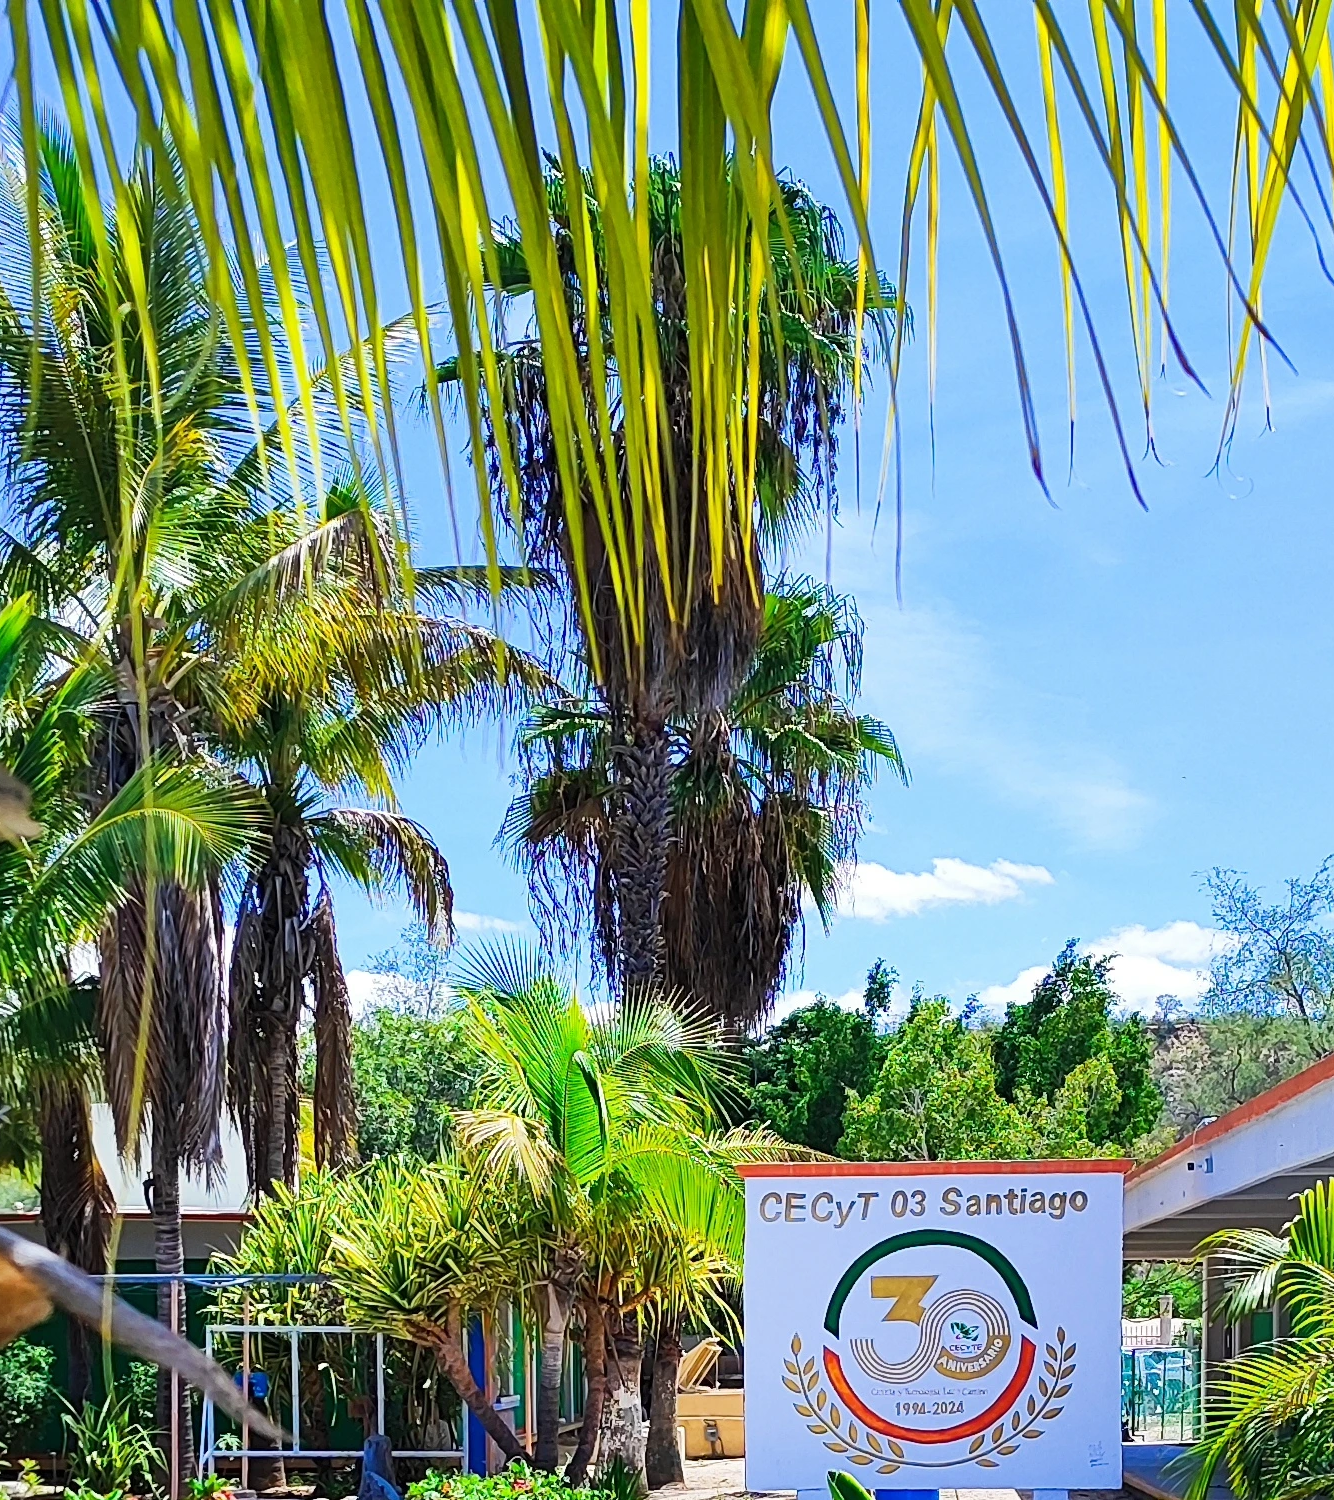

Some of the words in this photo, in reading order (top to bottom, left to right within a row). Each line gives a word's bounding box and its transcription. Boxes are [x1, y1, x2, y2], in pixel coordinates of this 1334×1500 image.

[760, 1191, 879, 1229] CECyT
[891, 1190, 927, 1218] 03
[939, 1186, 1088, 1220] Santiago
[850, 1274, 1010, 1384] 30
[936, 1338, 1003, 1373] ANIVERSARIO
[895, 1400, 965, 1416] 1994-2024
